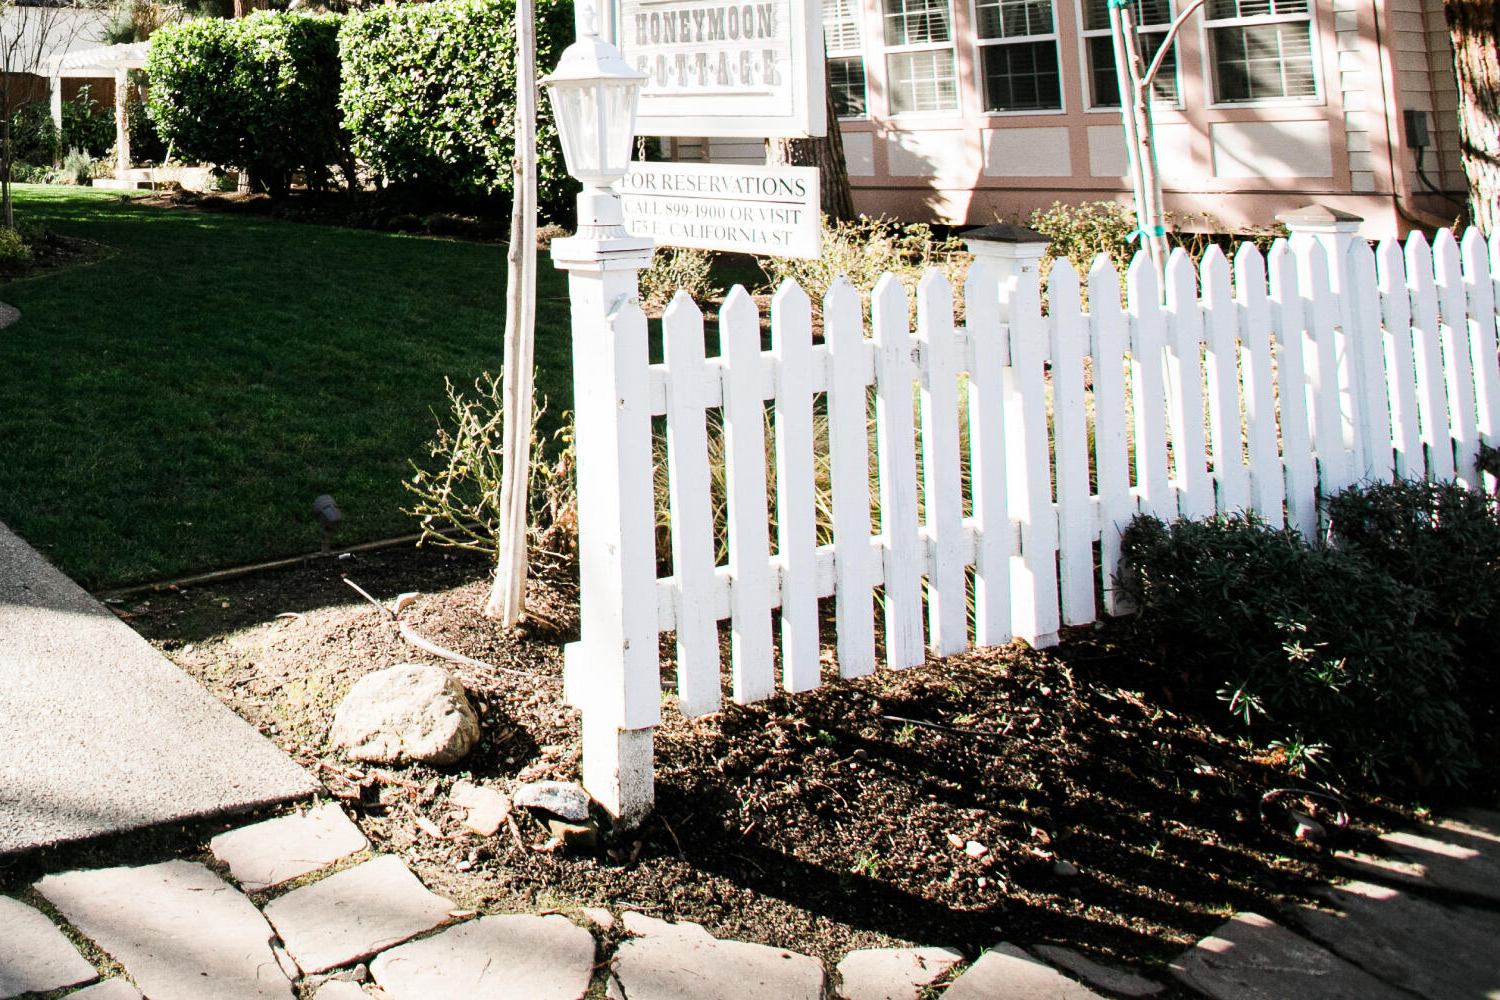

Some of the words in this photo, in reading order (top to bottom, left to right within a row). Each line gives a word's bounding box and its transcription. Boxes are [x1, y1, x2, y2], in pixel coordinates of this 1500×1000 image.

[635, 3, 773, 45] HONEYMOON
[621, 173, 657, 190] FOR
[662, 174, 806, 197] RESERVATIONS
[625, 200, 662, 216] CALL
[666, 202, 726, 220] 899-1900
[730, 206, 753, 223] OR
[758, 208, 802, 225] VISIT
[631, 220, 649, 234] 175
[670, 222, 767, 244] CALIFORNIA
[772, 230, 792, 246] ST
